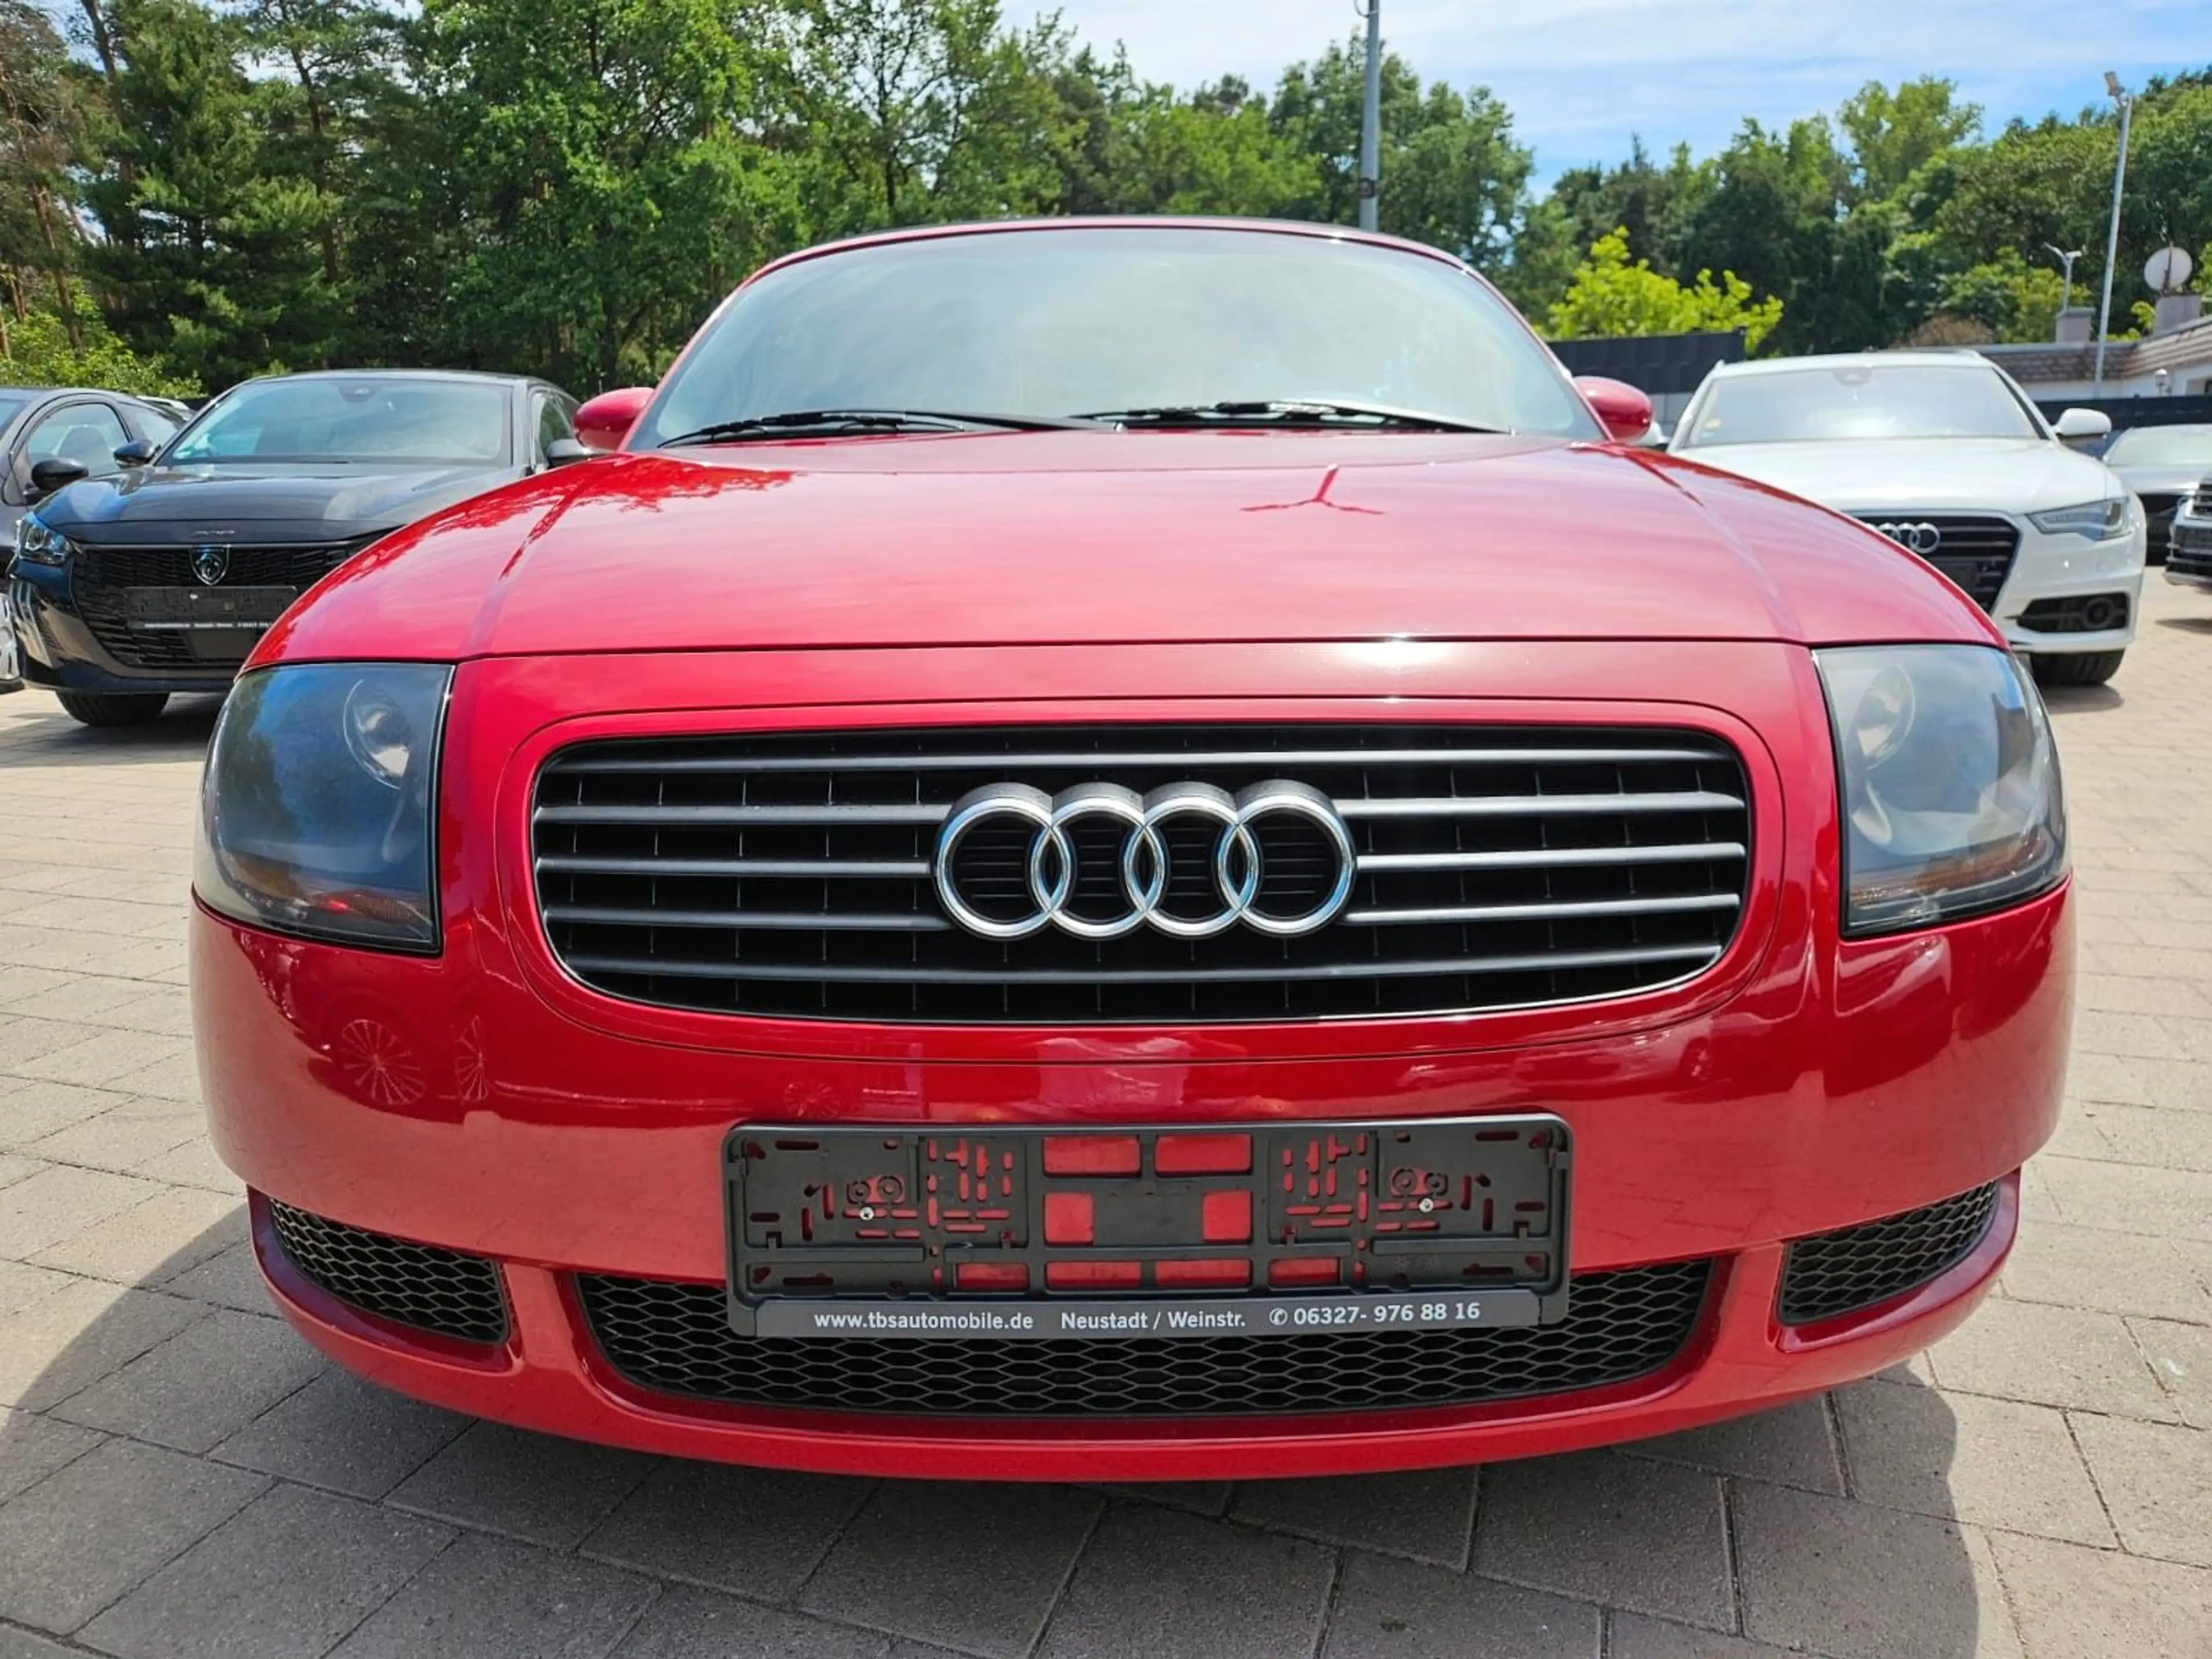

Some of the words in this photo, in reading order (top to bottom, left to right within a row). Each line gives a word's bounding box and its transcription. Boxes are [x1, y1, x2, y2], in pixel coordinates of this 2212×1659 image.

[813, 1311, 1034, 1330] www.tbsautomobile.de
[1060, 1311, 1148, 1330] Neustadt
[1152, 1311, 1162, 1330] /
[1167, 1310, 1246, 1328] Weinstr.
[1293, 1306, 1368, 1325] 06327-
[1373, 1304, 1415, 1323] 976
[1420, 1302, 1448, 1321] 88
[1455, 1301, 1480, 1320] 16
